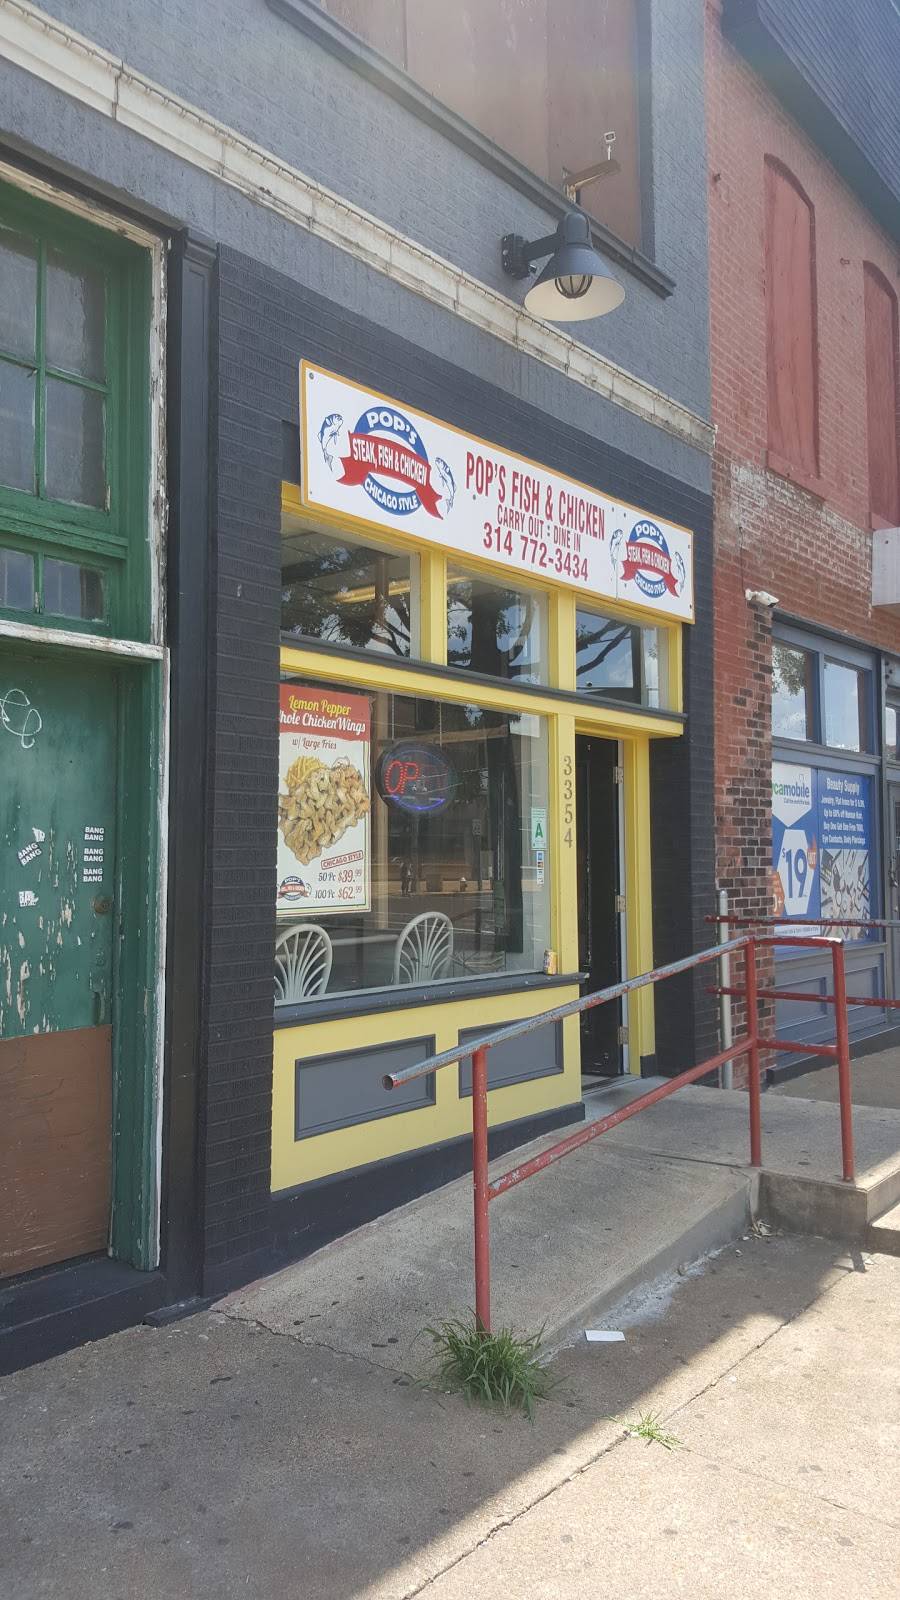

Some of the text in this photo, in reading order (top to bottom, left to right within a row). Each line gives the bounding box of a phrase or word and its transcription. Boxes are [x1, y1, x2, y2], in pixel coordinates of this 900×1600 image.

[366, 411, 418, 445] POP'S
[352, 438, 428, 486] STEAK, FISH & CHICKEN
[364, 478, 419, 511] CHICAGO STYLE
[466, 451, 605, 541] POP'S FISH & CHICKEN
[497, 504, 526, 533] CARRY
[528, 515, 545, 539] OUT
[553, 525, 571, 549] DINE
[573, 532, 581, 553] IN
[635, 523, 664, 545] POP'S
[483, 521, 589, 582] 314 772-3434
[289, 695, 352, 717] Lemon Pepper
[279, 709, 366, 736] hole Chicken Wings
[302, 738, 320, 750] Large
[321, 739, 337, 750] Fries
[826, 777, 844, 794] Beauty
[563, 755, 574, 849] 3354
[84, 833, 104, 841] BANG
[85, 826, 104, 834] BANG
[535, 822, 544, 838] A
[20, 848, 42, 866] BANG
[322, 856, 348, 868] CHICAGO
[318, 872, 328, 882] 50
[315, 889, 327, 899] 100
